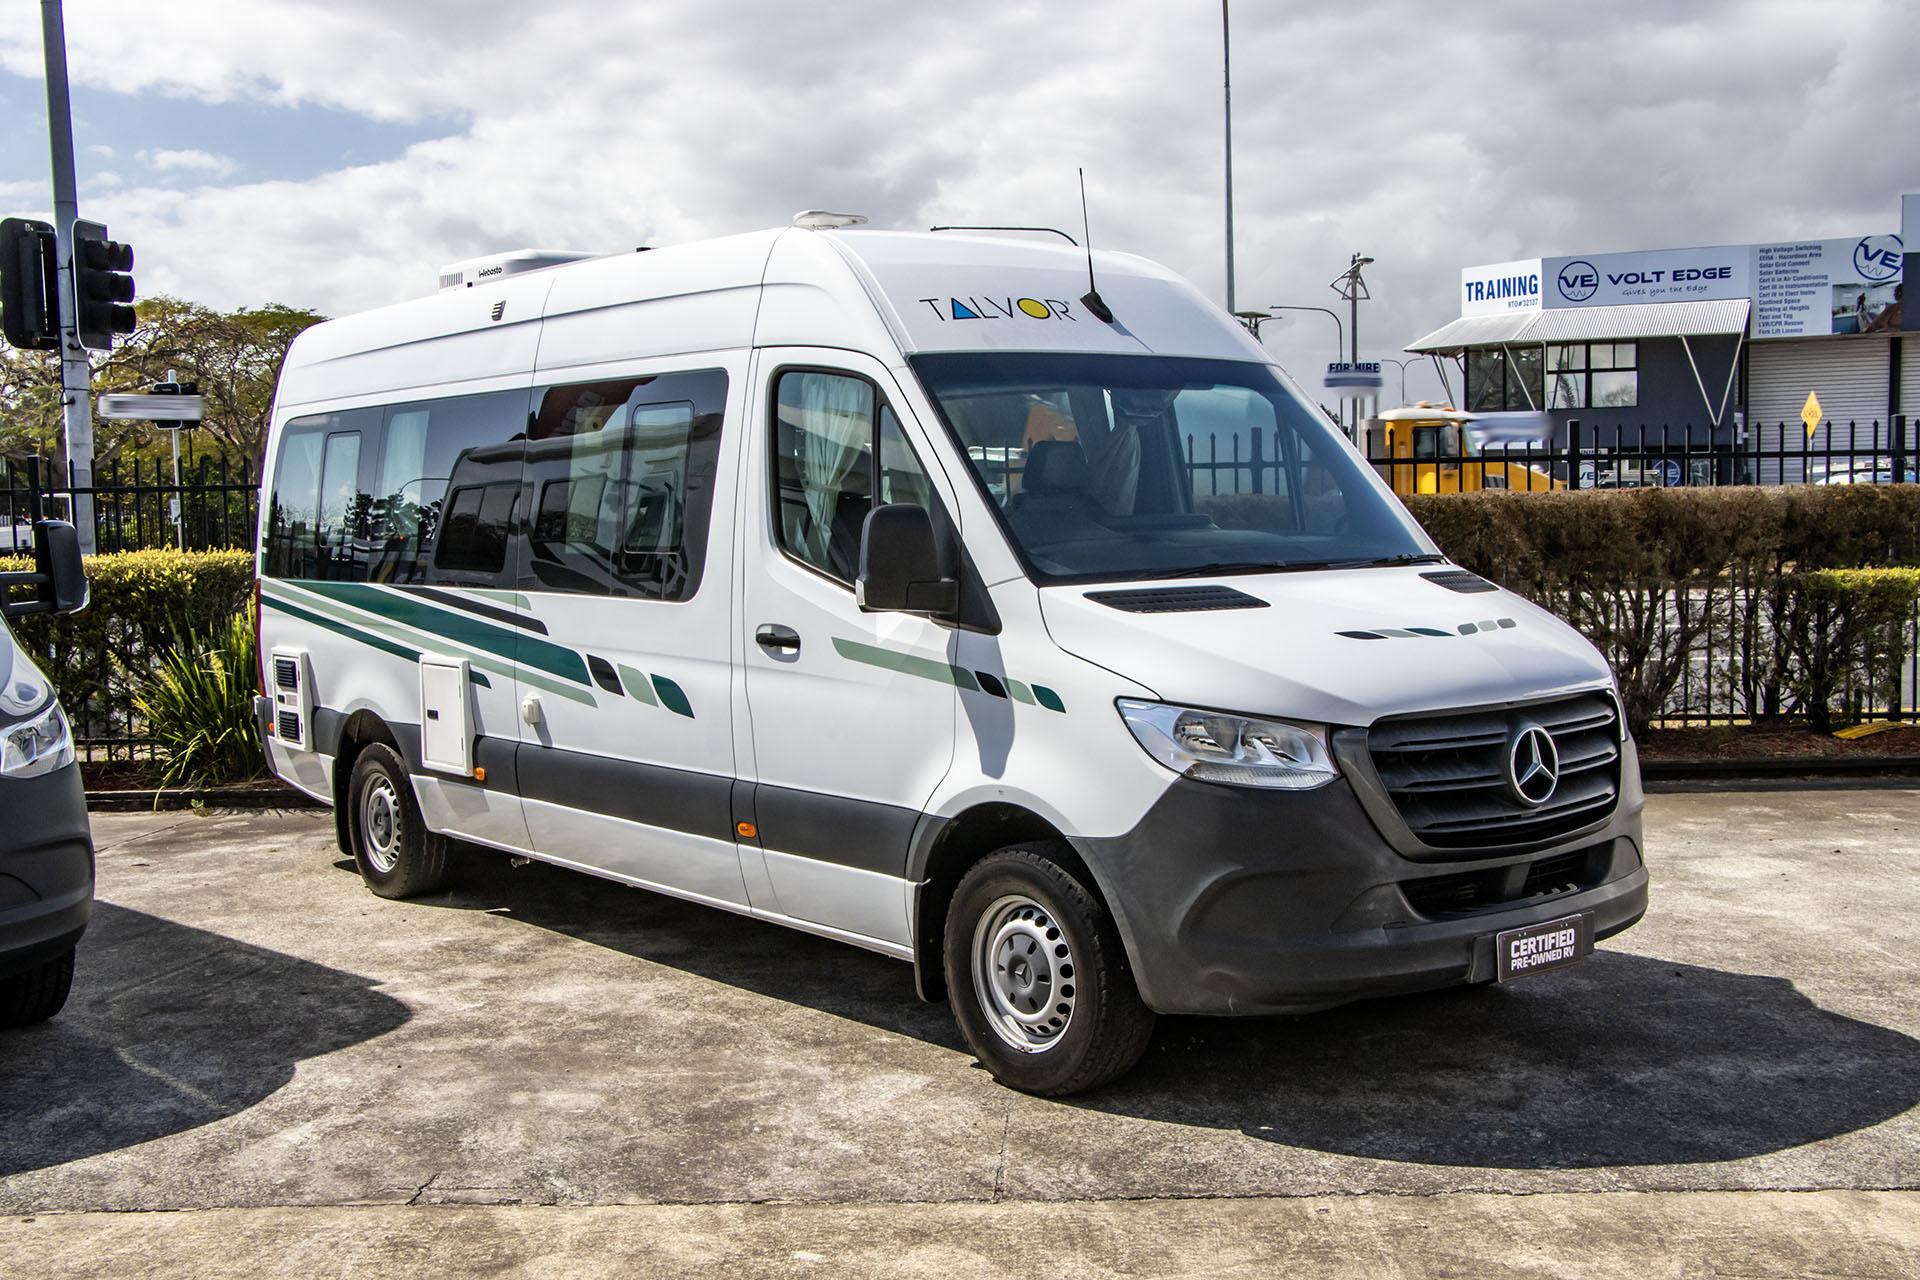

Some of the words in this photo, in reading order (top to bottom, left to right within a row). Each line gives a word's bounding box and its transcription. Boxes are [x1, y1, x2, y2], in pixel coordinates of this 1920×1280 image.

[1859, 242, 1902, 270] VE
[478, 266, 502, 278] Webasto
[1559, 274, 1598, 289] VE
[1607, 270, 1666, 286] VOLT
[1672, 266, 1732, 282] EDGE
[1465, 274, 1538, 302] TRAINING
[1622, 287, 1646, 297] Gives
[1650, 287, 1666, 298] you
[1686, 284, 1708, 294] Edge
[918, 296, 1077, 321] TALVOR
[1508, 298, 1539, 309] RTO#32137
[1328, 363, 1350, 373] FOR
[1354, 362, 1380, 373] HIRE
[1511, 928, 1575, 958] CERTIFIED
[1511, 948, 1562, 971] PRE-OWNED
[1563, 945, 1575, 958] RV
